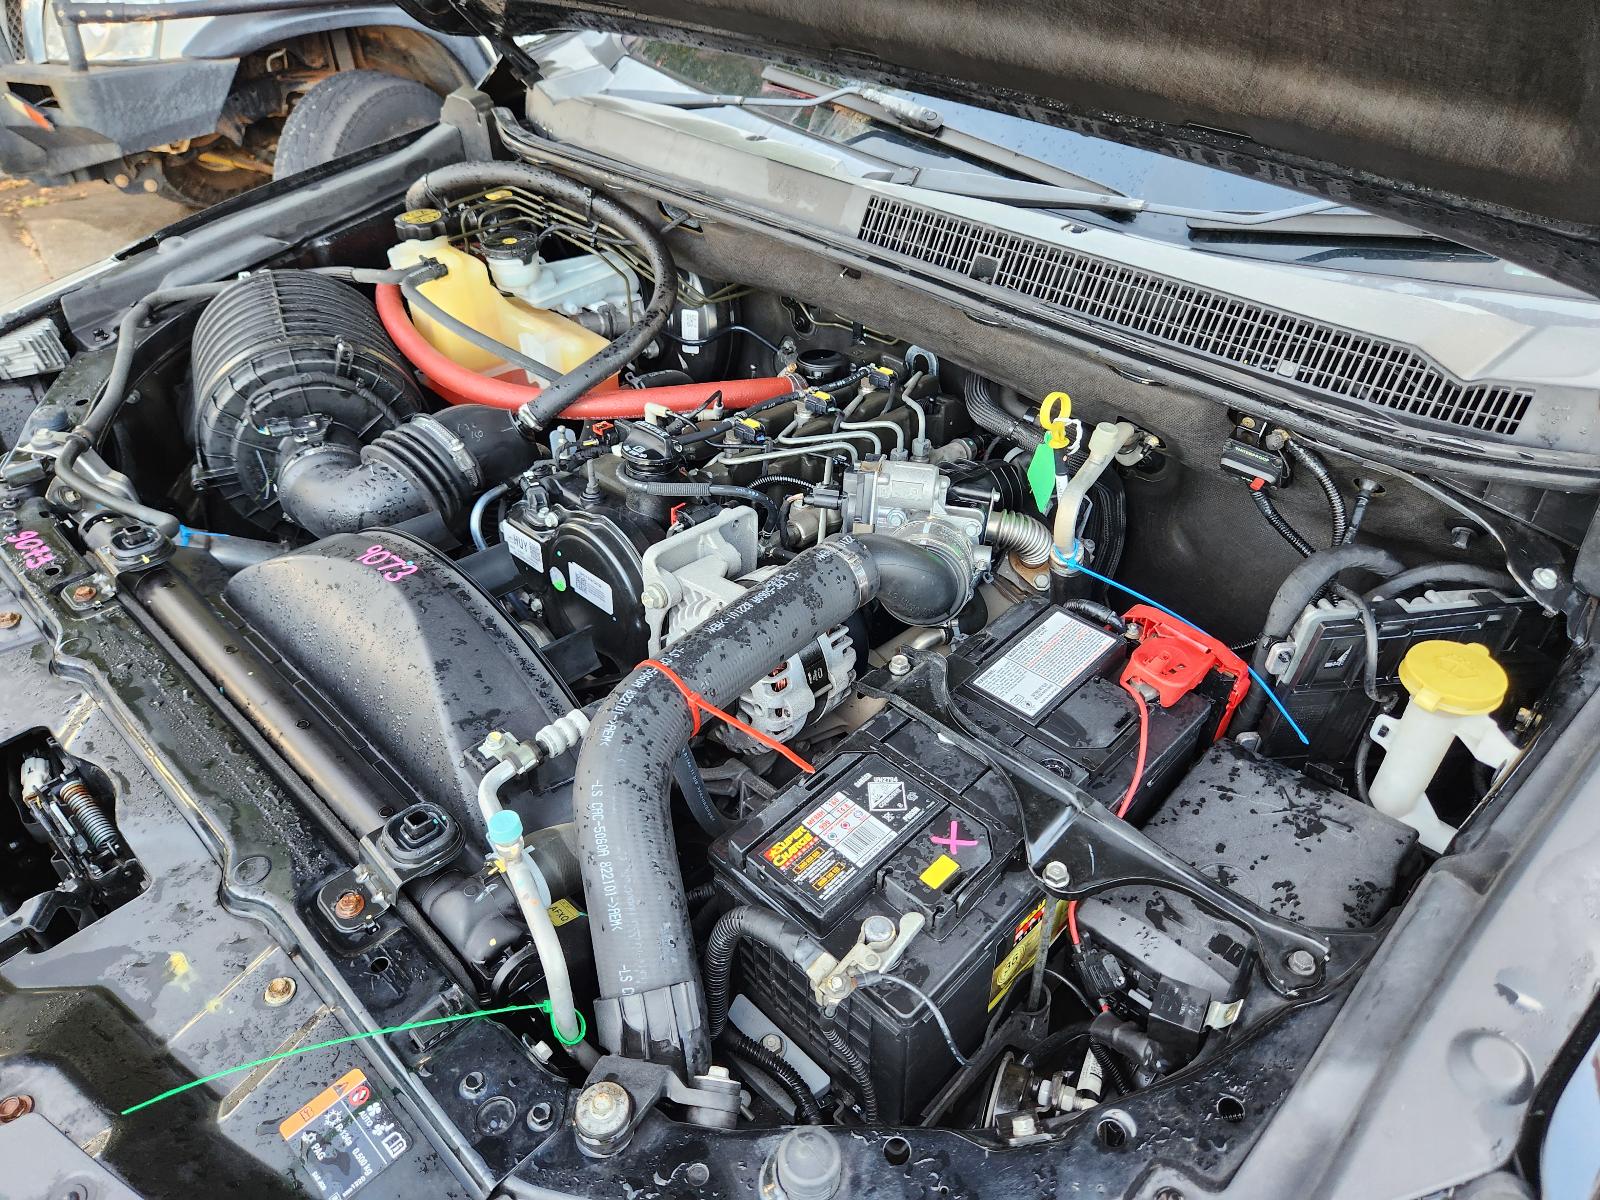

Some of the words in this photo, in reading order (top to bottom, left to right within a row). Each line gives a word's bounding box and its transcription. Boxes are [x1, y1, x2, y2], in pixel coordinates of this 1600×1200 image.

[1235, 446, 1270, 462] WATERPROOF
[356, 544, 418, 582] 9073
[591, 802, 610, 858] CAC-5060A
[772, 832, 814, 867] CHARGE
[600, 861, 623, 932] 822101->AEM<
[358, 1110, 374, 1127] AUTO
[335, 1122, 353, 1147] R-134a
[311, 1142, 326, 1161] PAG
[352, 1147, 369, 1167] 0.500
